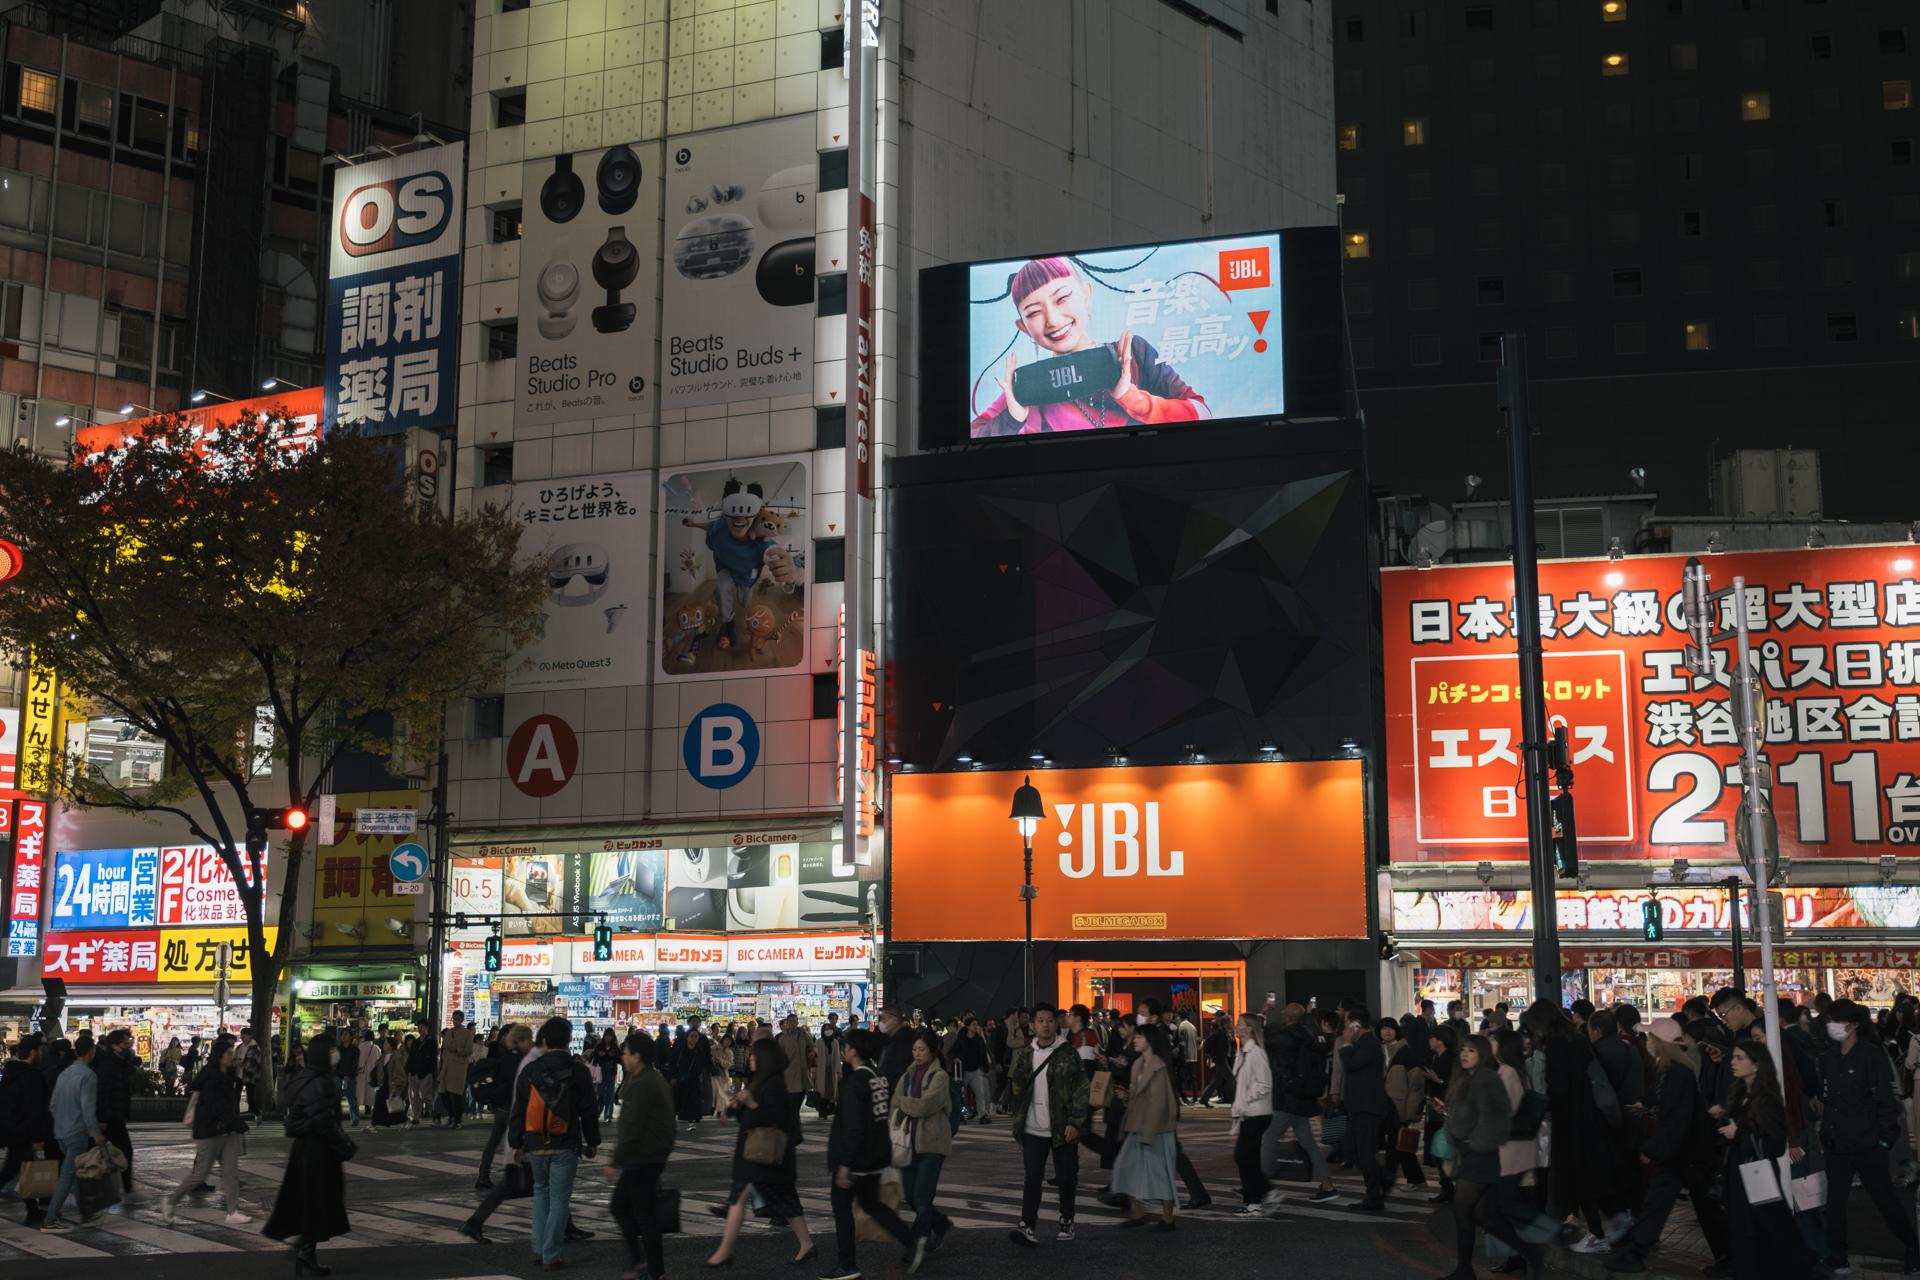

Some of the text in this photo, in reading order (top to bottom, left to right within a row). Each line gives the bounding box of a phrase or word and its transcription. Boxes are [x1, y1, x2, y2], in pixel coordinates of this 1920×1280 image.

[861, 0, 880, 47] RA
[345, 175, 445, 245] OS
[859, 226, 872, 288] 免税
[1229, 260, 1262, 280] JBL
[341, 271, 443, 353] 調剤
[670, 334, 724, 355] Beats
[529, 353, 577, 374] Beats
[670, 354, 729, 376] Studio
[737, 346, 784, 369] Buds
[337, 348, 439, 426] 薬局
[527, 370, 617, 395] Studio Pro
[1050, 365, 1083, 388] JBL
[539, 482, 622, 505] ひろげよう、
[523, 500, 637, 523] キミごと世界を。
[576, 658, 604, 672] Quest
[604, 658, 612, 668] 3
[517, 723, 566, 783] A
[699, 716, 747, 777] B
[1429, 714, 1614, 769] エスス
[1648, 750, 1920, 845] 211台
[361, 811, 413, 824] 道玄坂下
[617, 840, 663, 850] ビックカメラ
[747, 834, 797, 843] BicCamera
[1054, 801, 1184, 879] JBL
[14, 805, 44, 917] スギ薬局
[491, 846, 537, 855] BicCamera
[97, 863, 126, 880] hour
[55, 864, 91, 918] 24
[91, 880, 130, 916] 時間
[131, 853, 157, 922] 営業
[185, 886, 266, 903] Cosme
[455, 877, 493, 899] 10 5
[573, 869, 581, 904] Vivobook
[226, 903, 249, 921] 화장
[572, 906, 580, 927] ASS
[1556, 894, 1813, 929] 甲鉄城のカバリ
[9, 940, 37, 955] 営業
[44, 937, 157, 973] スギ薬局
[164, 937, 268, 973] 処方せ
[583, 948, 644, 963] BI AMERA
[658, 947, 723, 962] ビックカメラ
[738, 947, 804, 961] BIC CAMERA
[815, 945, 870, 960] ビックカメ
[1448, 952, 1569, 968] パチンコ&スト
[563, 985, 586, 993] ANKER
